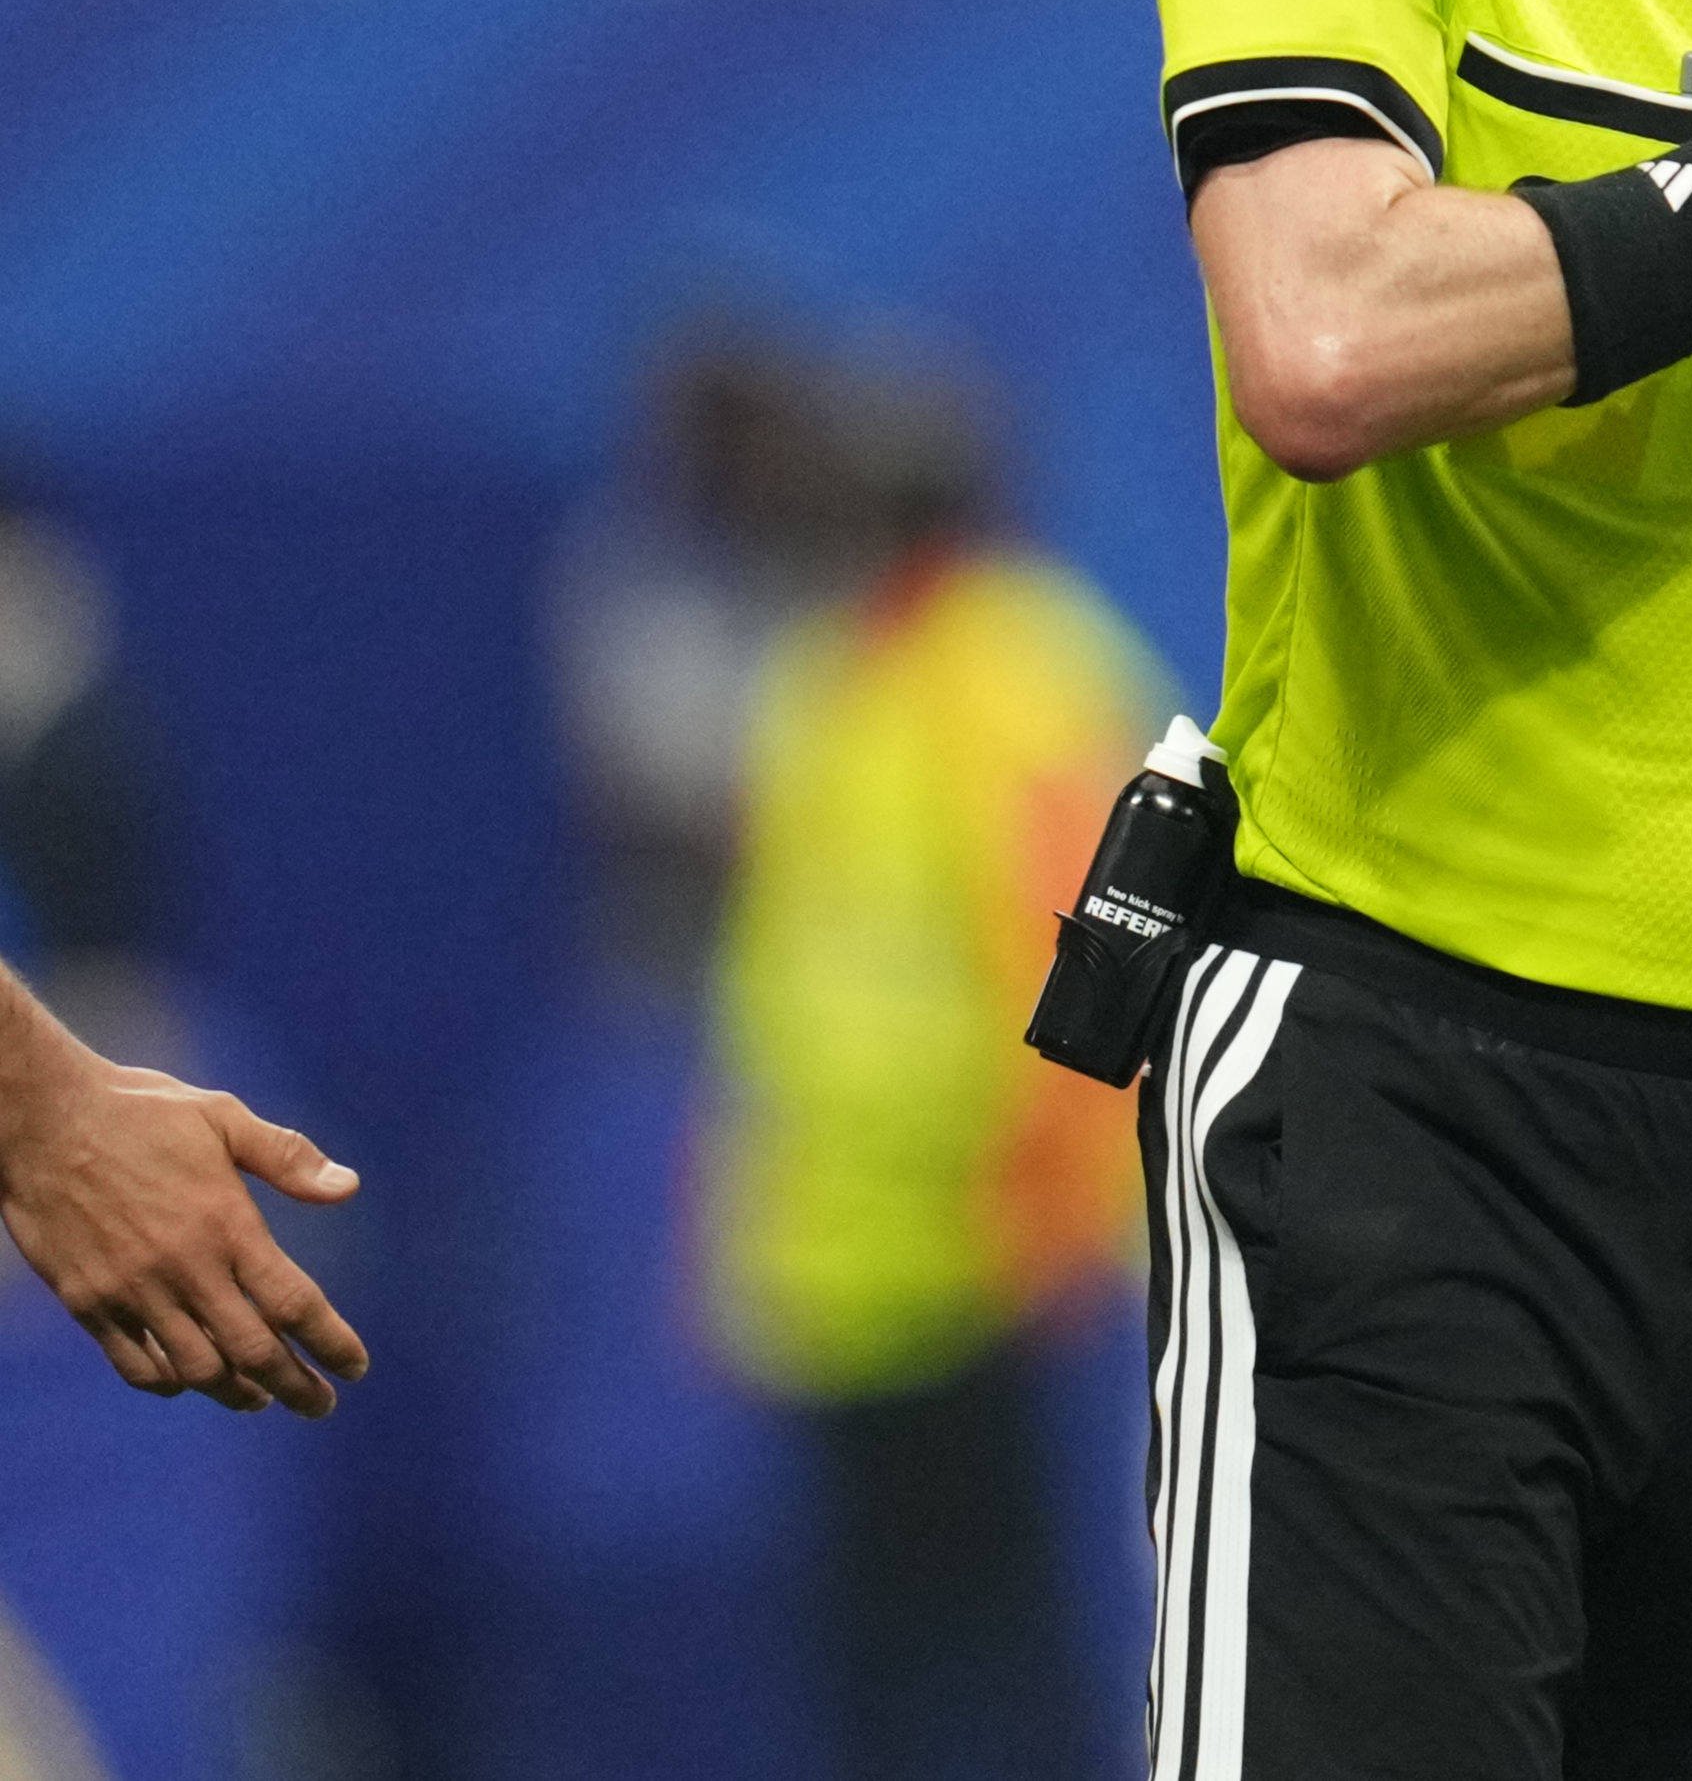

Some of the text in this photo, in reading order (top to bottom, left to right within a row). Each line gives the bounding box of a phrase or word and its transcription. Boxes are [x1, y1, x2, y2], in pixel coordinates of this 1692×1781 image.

[1106, 885, 1127, 901] free
[1127, 893, 1151, 911] kick
[1151, 905, 1177, 923] spray
